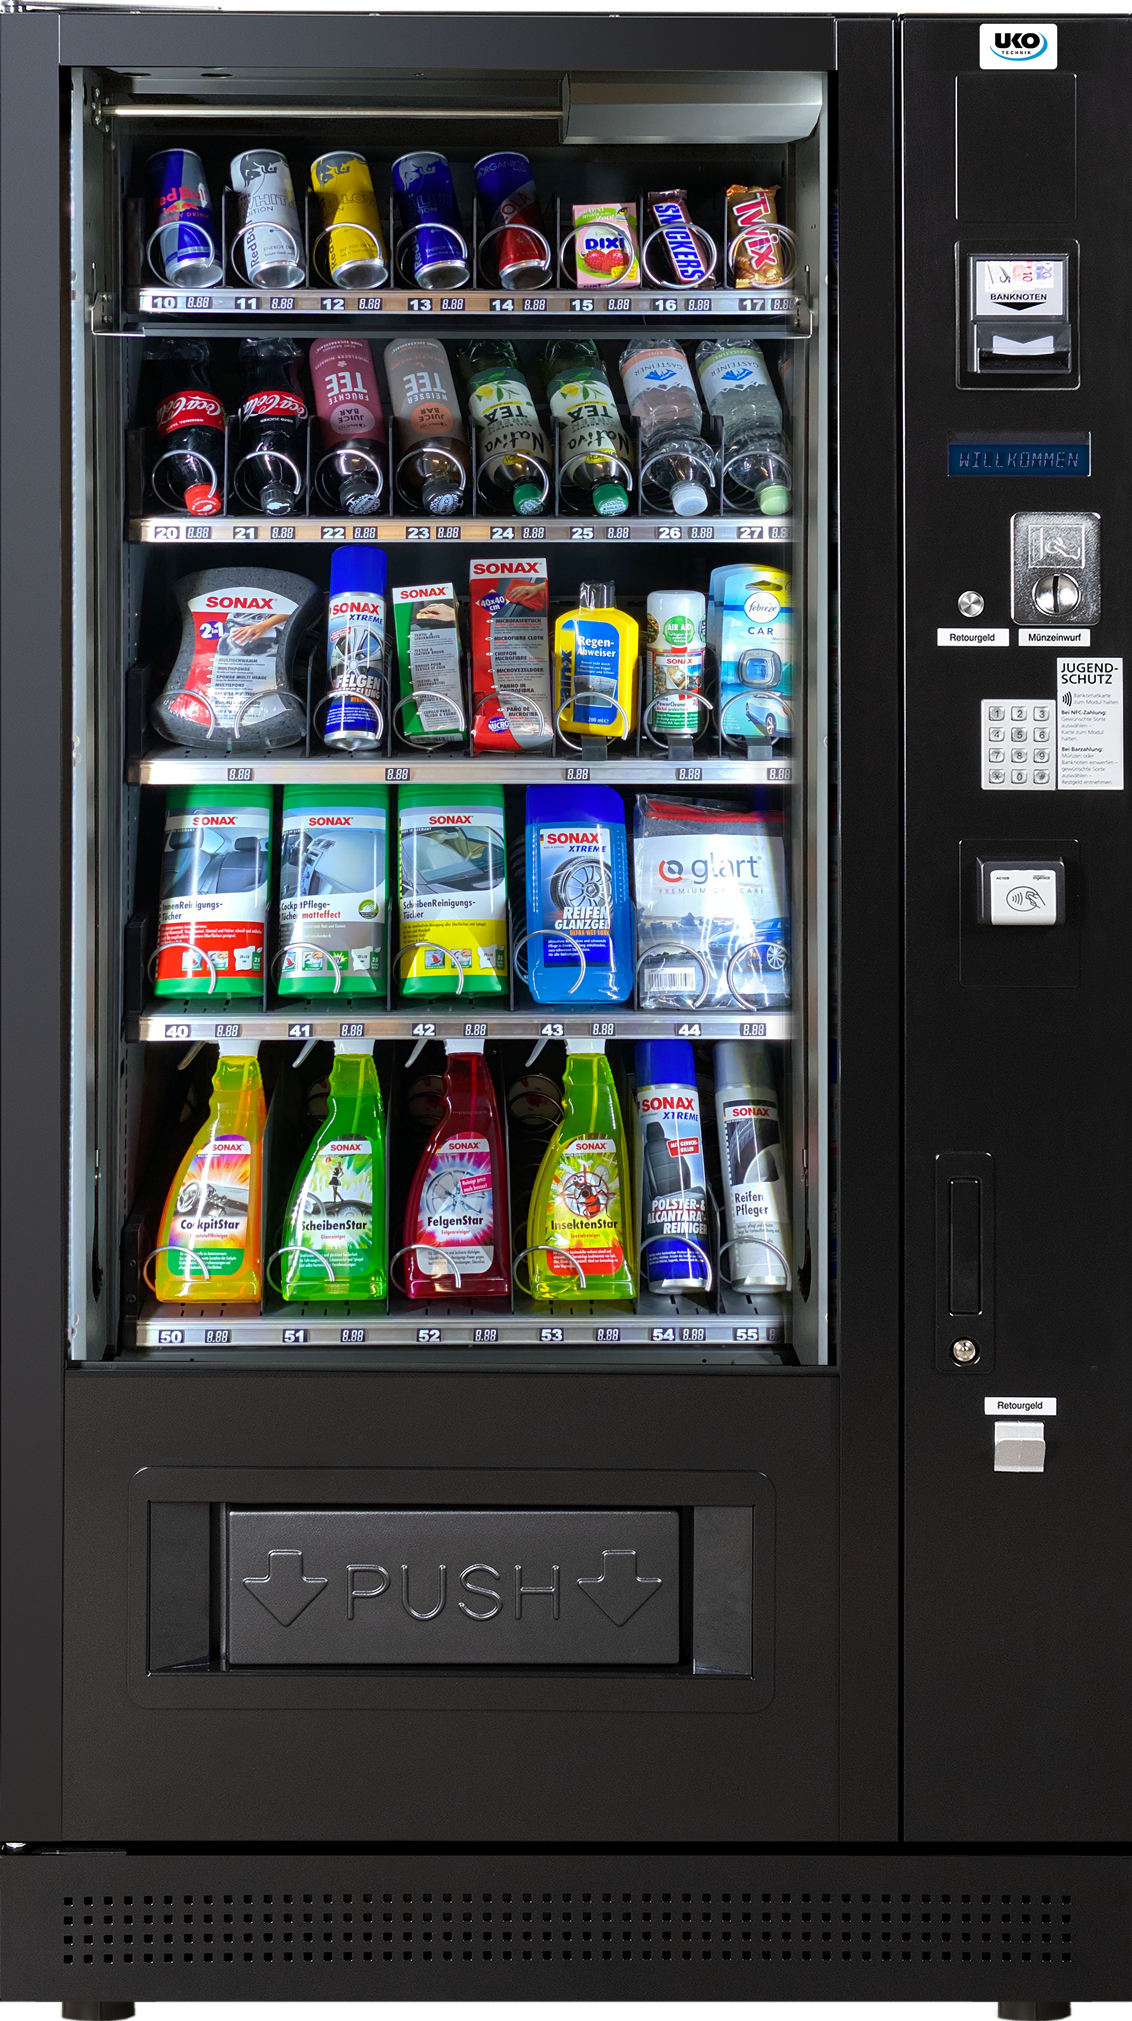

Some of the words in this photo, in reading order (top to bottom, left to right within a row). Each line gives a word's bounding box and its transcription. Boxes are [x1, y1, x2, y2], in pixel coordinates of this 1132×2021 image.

[995, 33, 1040, 48] UKO
[654, 204, 704, 282] SNICKERS
[153, 298, 176, 308] 10
[187, 296, 210, 308] 8.88
[236, 298, 256, 310] 11
[271, 298, 294, 309] 8.88
[323, 298, 344, 310] 12
[359, 298, 381, 310] 8.88
[410, 299, 431, 310] 13
[442, 298, 464, 310] 8.88
[492, 300, 514, 311] 14
[524, 299, 546, 310] 8.88
[572, 300, 594, 311] 15
[608, 299, 630, 310] 8.88
[656, 300, 676, 311] 16
[688, 300, 710, 310] 8.88
[743, 300, 762, 311] 17
[634, 362, 683, 376] GASTEINER
[710, 360, 759, 377] GASTEINER
[325, 371, 368, 397] TEE
[403, 372, 446, 396] TEE
[327, 392, 369, 406] FRÜCHTE
[407, 392, 448, 404] WEISSER
[156, 396, 224, 422] Coca-Cola
[240, 394, 309, 422] Coca-Cola
[337, 414, 364, 424] JUICE
[418, 414, 444, 422] JUICE
[483, 405, 528, 426] TEA
[567, 404, 612, 424] TEA
[488, 418, 530, 432] GREEN
[570, 416, 614, 430] GREEN
[484, 430, 544, 454] Nativa
[567, 430, 629, 454] Nativa
[959, 452, 1079, 468] WILLKOMMEN
[156, 528, 178, 539] 20
[187, 527, 210, 539] 8.88
[234, 528, 254, 539] 21
[271, 527, 294, 539] 8.88
[322, 528, 344, 539] 22
[354, 527, 376, 539] 8.88
[408, 528, 430, 539] 23
[437, 526, 460, 538] 8.88
[492, 528, 514, 539] 24
[523, 527, 544, 538] 8.88
[572, 528, 594, 539] 25
[608, 527, 630, 538] 8.88
[658, 528, 680, 539] 26
[692, 527, 713, 538] 8.88
[740, 528, 762, 539] 27
[473, 562, 540, 574] SONAX
[400, 587, 446, 600] SONAX
[206, 596, 274, 610] SONAX
[481, 596, 505, 608] 40x40
[749, 601, 777, 612] febreze
[332, 602, 380, 615] SONAX
[349, 614, 383, 626] XTREME
[748, 626, 774, 636] CAR
[580, 636, 614, 648] Regen-
[950, 633, 996, 643] Retourgeld
[1028, 633, 1082, 642] Münzeinwurf
[576, 647, 616, 658] Abweiser
[1060, 662, 1119, 674] JUGEND-
[336, 674, 381, 690] FELGEN
[1061, 674, 1112, 684] SCHUTZ
[488, 720, 510, 731] MICRO
[1040, 731, 1046, 739] 6
[994, 752, 1000, 760] 7
[1017, 752, 1022, 760] 8
[1040, 752, 1046, 760] 9
[229, 769, 250, 780] 8.88
[387, 769, 409, 780] 8.88
[567, 768, 588, 780] 8.88
[679, 769, 700, 780] 8.88
[770, 768, 790, 780] 8.88
[1017, 773, 1022, 781] 0
[192, 816, 236, 826] SONAX
[308, 817, 352, 826] SONAX
[429, 816, 472, 824] SONAX
[546, 832, 599, 844] SONAX
[691, 852, 761, 884] glart
[282, 900, 331, 910] CockptPflege-
[162, 912, 182, 921] Tücher
[282, 911, 299, 920] Tüche
[302, 910, 341, 919] matteffect
[563, 906, 608, 919] REIFEN
[554, 919, 610, 930] GLANZGEL
[166, 1026, 188, 1037] 40
[216, 1025, 239, 1036] 8.88
[290, 1026, 310, 1036] 41
[342, 1024, 363, 1036] 8.88
[413, 1024, 435, 1036] 42
[465, 1024, 486, 1036] 8.88
[542, 1024, 563, 1036] 43
[593, 1024, 614, 1035] 8.88
[678, 1024, 700, 1036] 44
[743, 1024, 764, 1035] 8.88
[642, 1096, 694, 1112] SONAX
[662, 1111, 698, 1122] XTREME
[732, 1108, 770, 1117] SONAX
[330, 1144, 361, 1152] SONAX
[652, 1199, 700, 1211] POLSTER-
[736, 1204, 768, 1218] Pfleger
[180, 1218, 240, 1232] CokpitStar
[302, 1219, 368, 1231] ScheibenStar
[428, 1216, 484, 1228] FelgenStar
[550, 1218, 618, 1230] InsektenStar
[663, 1222, 708, 1236] REINIGER
[160, 1331, 182, 1342] 50
[206, 1330, 228, 1342] 8.88
[284, 1331, 304, 1342] 51
[342, 1330, 364, 1342] 8.88
[418, 1330, 440, 1342] 52
[474, 1330, 496, 1342] 8.88
[541, 1330, 562, 1341] 53
[597, 1330, 619, 1341] 8.88
[652, 1329, 674, 1340] 54
[682, 1329, 704, 1340] 8.88
[736, 1329, 758, 1340] 55
[997, 1401, 1044, 1412] Retourgeld
[346, 1562, 562, 1622] PUSH
